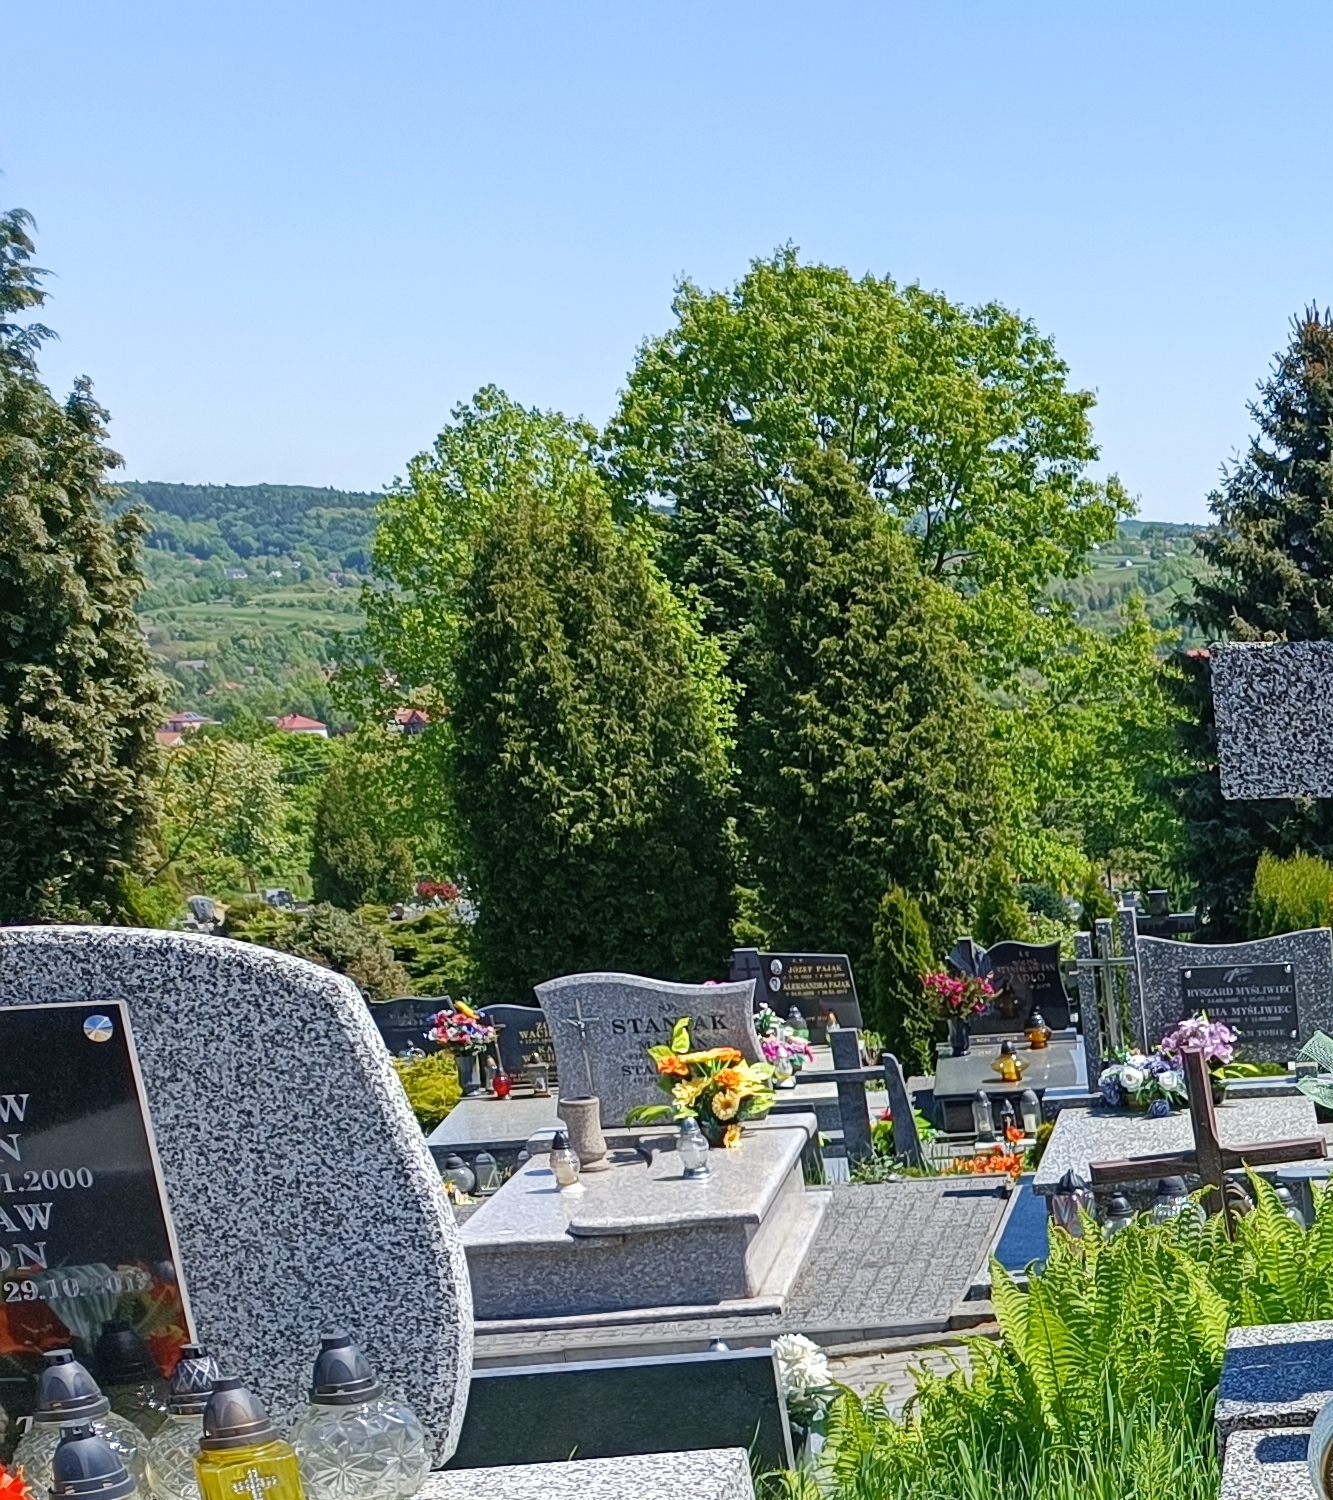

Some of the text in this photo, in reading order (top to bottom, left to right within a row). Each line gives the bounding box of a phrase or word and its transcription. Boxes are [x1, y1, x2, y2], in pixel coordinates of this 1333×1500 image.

[1186, 984, 1293, 998] RYSZARD MYŚLIWIEC
[1231, 1004, 1292, 1016] MYŚLIWIEC
[611, 1014, 729, 1035] STANAK
